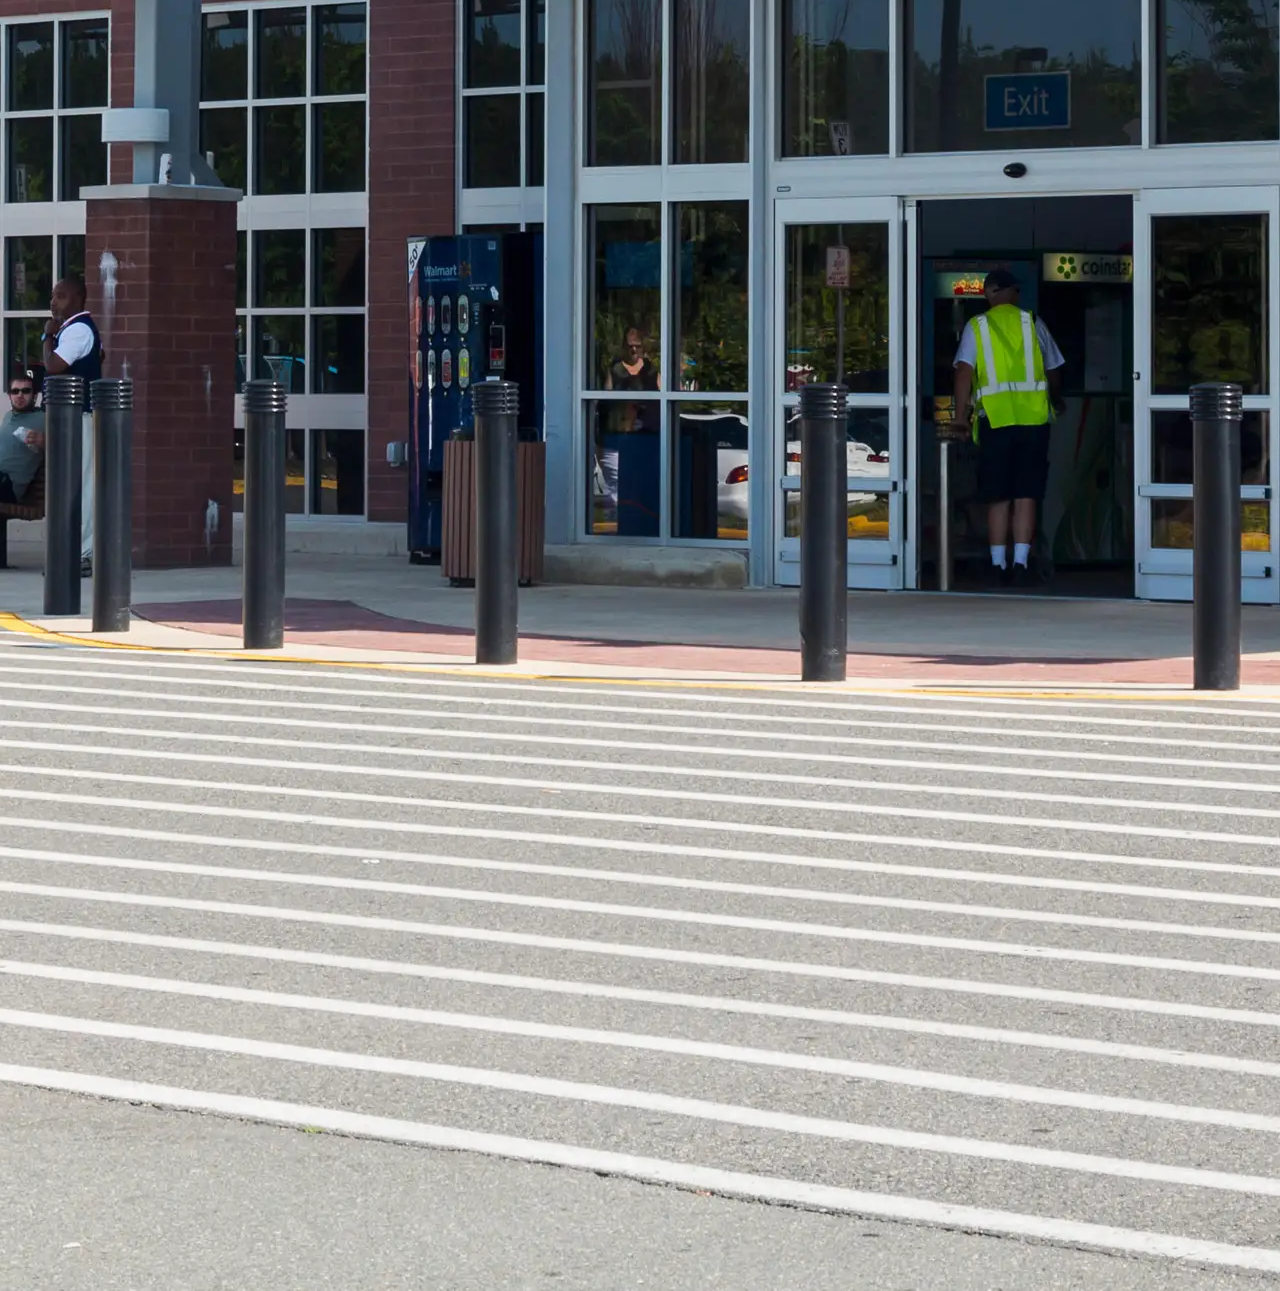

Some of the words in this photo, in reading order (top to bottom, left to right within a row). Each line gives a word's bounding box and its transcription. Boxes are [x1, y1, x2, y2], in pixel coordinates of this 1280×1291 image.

[1004, 87, 1050, 116] Exit
[424, 264, 457, 277] Walmart
[1081, 258, 1132, 276] coinstar
